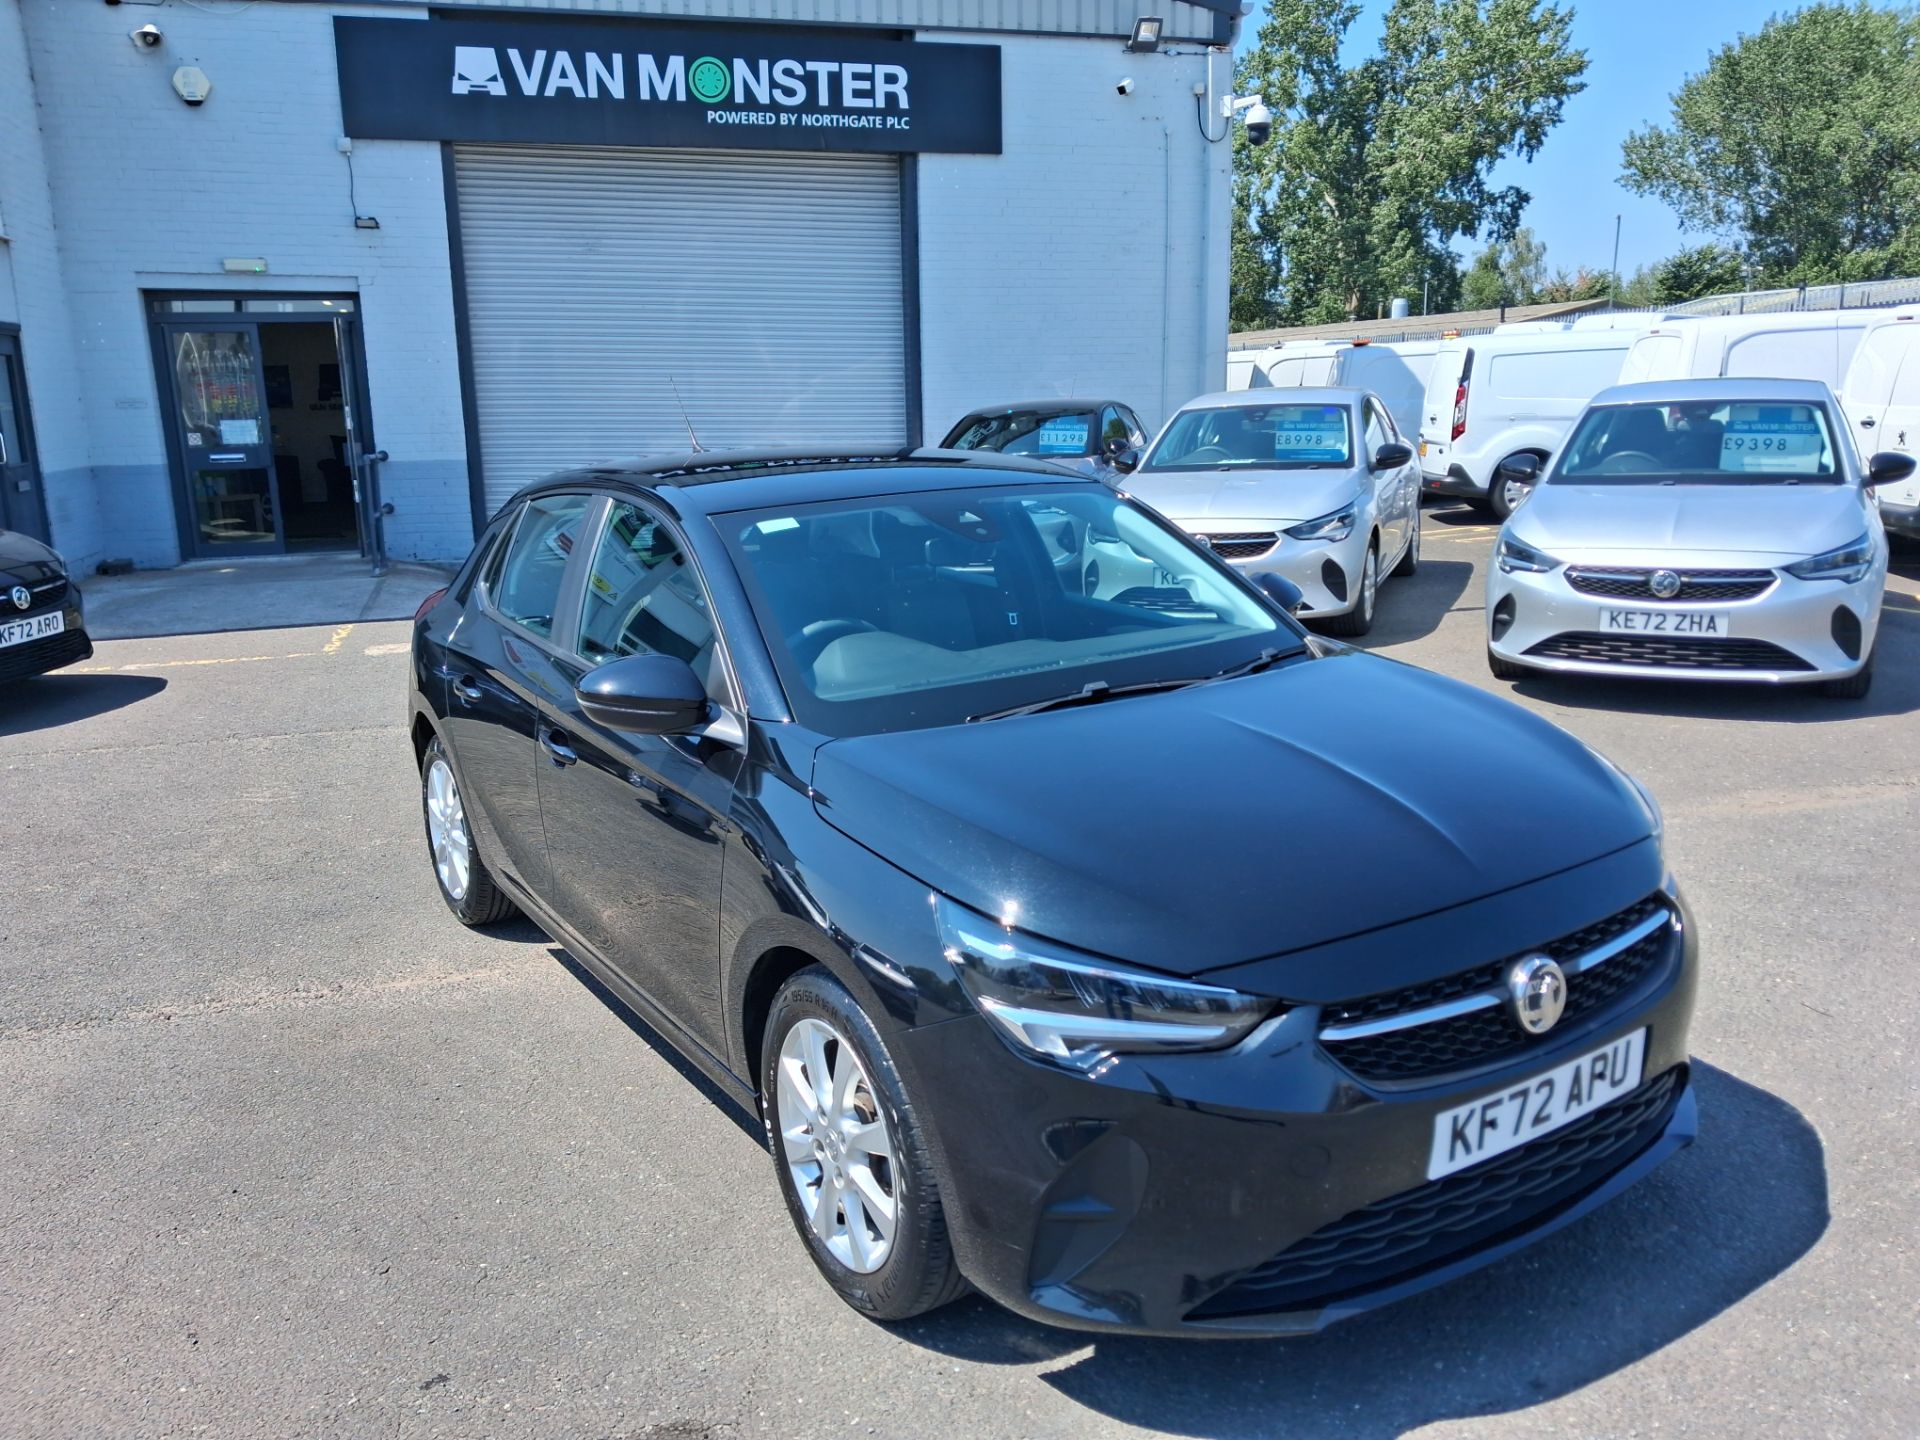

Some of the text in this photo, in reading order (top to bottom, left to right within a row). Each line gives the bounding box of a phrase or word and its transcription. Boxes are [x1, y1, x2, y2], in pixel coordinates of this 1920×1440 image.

[507, 48, 910, 109] VAN MONSTER
[707, 110, 910, 129] POWERED BY NORTHGATE PLC
[1277, 434, 1323, 445] £8998
[1724, 437, 1787, 451] £9398
[1609, 610, 1718, 633] KE72 ZHA
[0, 622, 34, 645] KF72
[1448, 1040, 1632, 1163] KF72 APU
